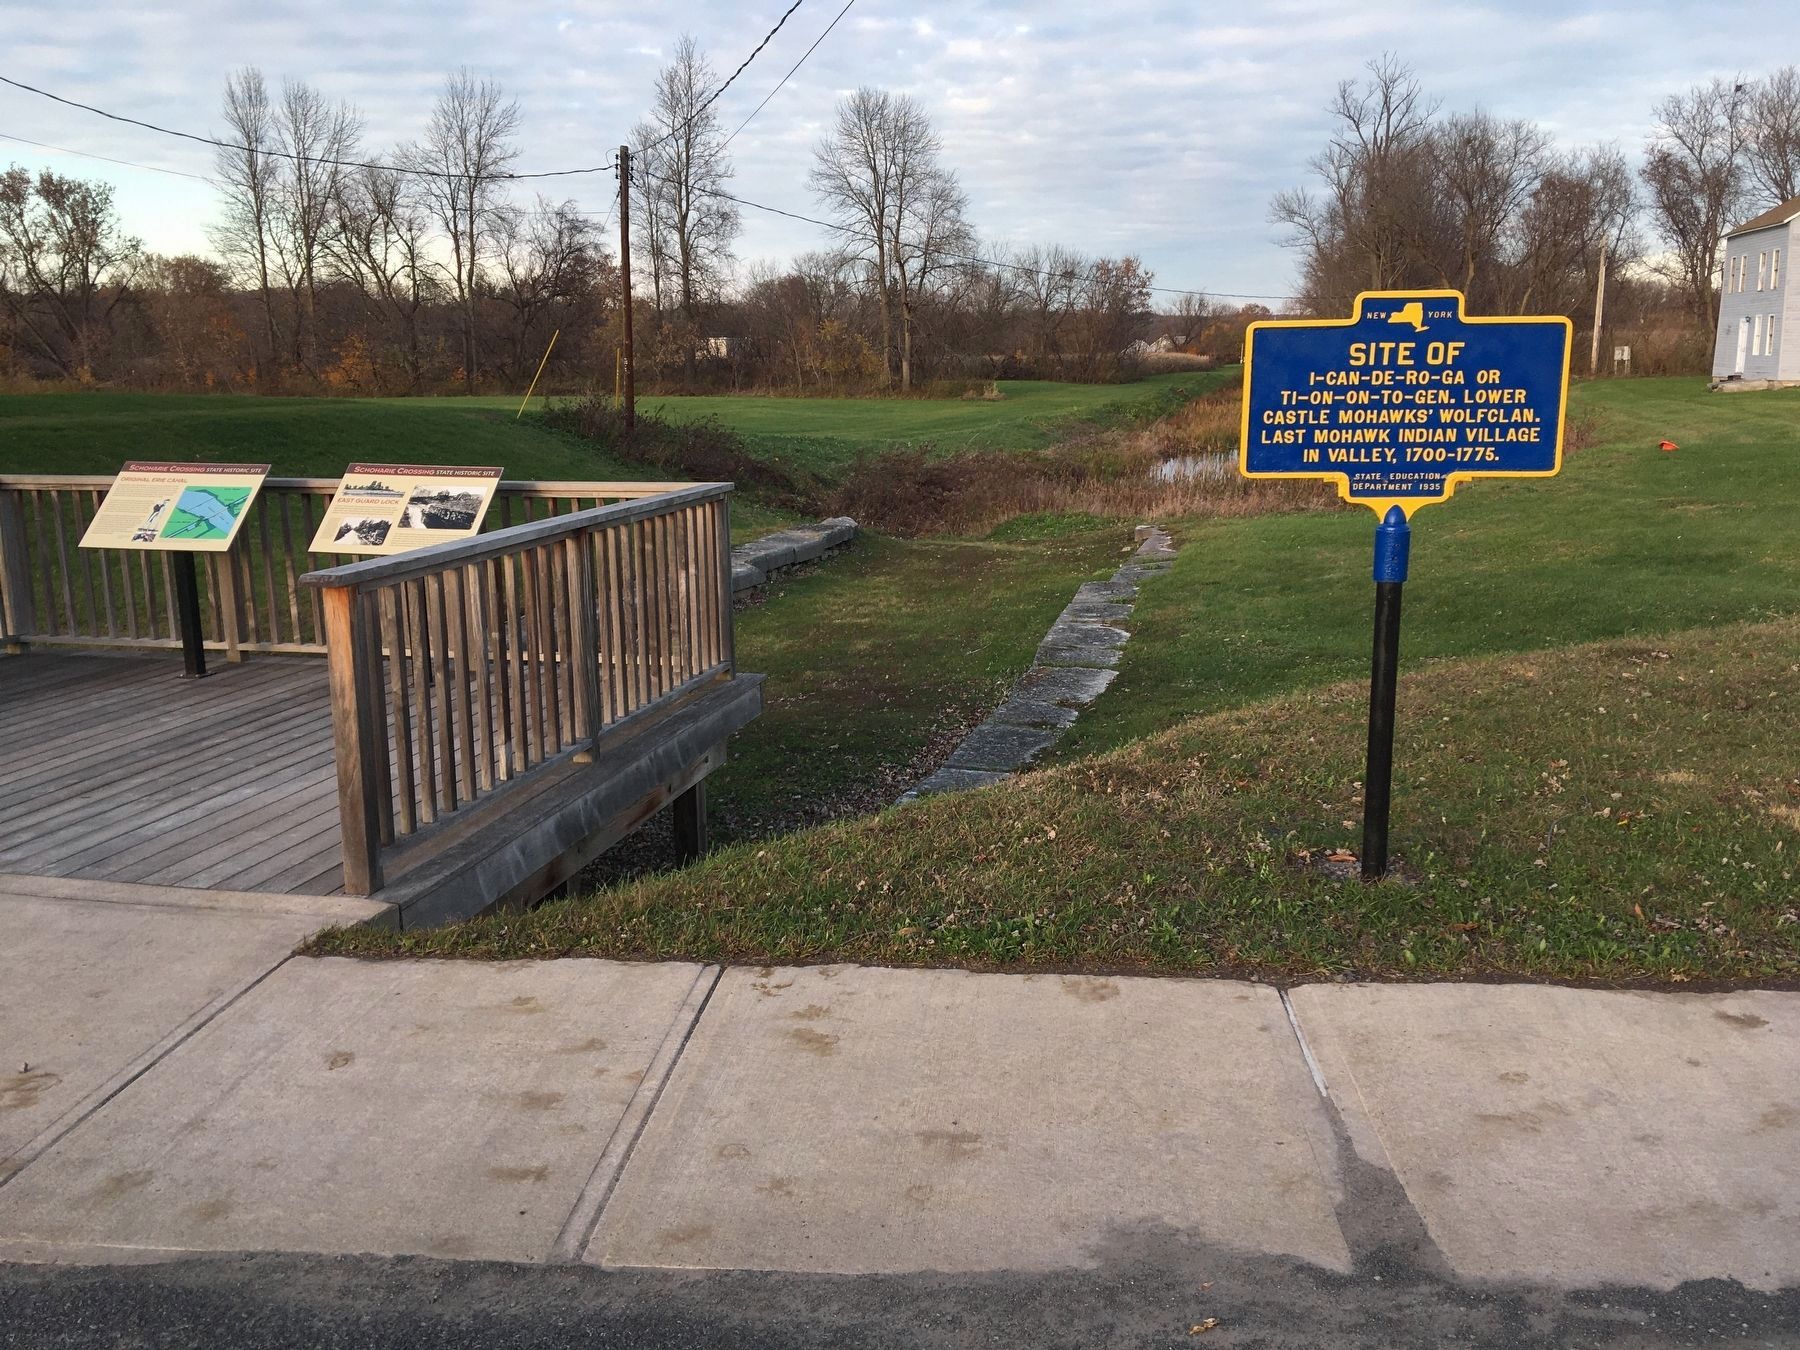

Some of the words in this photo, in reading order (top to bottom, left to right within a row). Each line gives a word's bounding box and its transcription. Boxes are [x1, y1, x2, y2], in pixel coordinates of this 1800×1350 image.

[1366, 312, 1387, 320] NEW
[1428, 311, 1453, 319] YORK
[1349, 342, 1417, 366] SITE
[1426, 341, 1466, 365] OF
[1309, 370, 1466, 386] I-CAN-DE-RO-GA
[1476, 369, 1502, 384] OR
[1281, 389, 1456, 406] TI-ON-ON-TO-GEN.
[1464, 389, 1527, 404] LOWER
[1263, 410, 1330, 425] CASTLE
[1338, 409, 1433, 424] MOHAWKS'
[1261, 429, 1306, 444] LAST
[1314, 428, 1391, 443] MOHAWK
[1398, 428, 1457, 443] INDIAN
[1466, 427, 1541, 442] VILLAGE
[1303, 448, 1320, 463] IN
[1328, 448, 1397, 464] VALLEY,
[1406, 447, 1500, 462] 1700-1775.
[1389, 472, 1441, 480] EDUCATION
